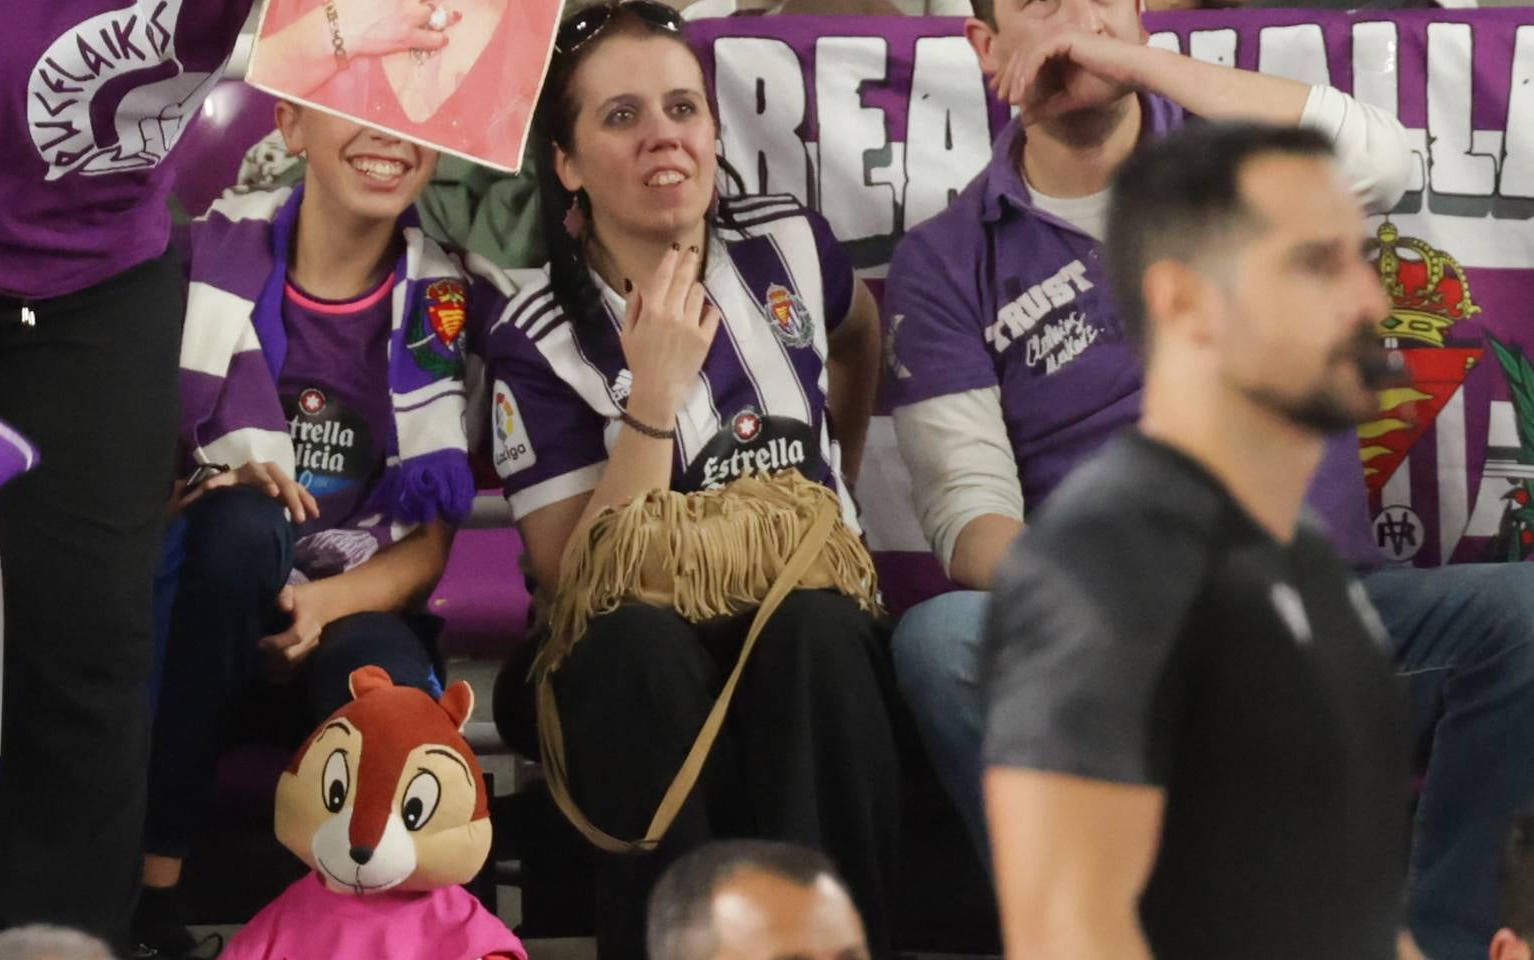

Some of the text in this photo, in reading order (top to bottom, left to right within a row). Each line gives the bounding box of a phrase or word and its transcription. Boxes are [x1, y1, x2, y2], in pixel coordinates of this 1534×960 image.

[715, 36, 1014, 240] REA
[985, 259, 1094, 353] TRUST
[289, 414, 354, 448] trella
[295, 442, 345, 473] licia
[700, 437, 805, 487] Estrella
